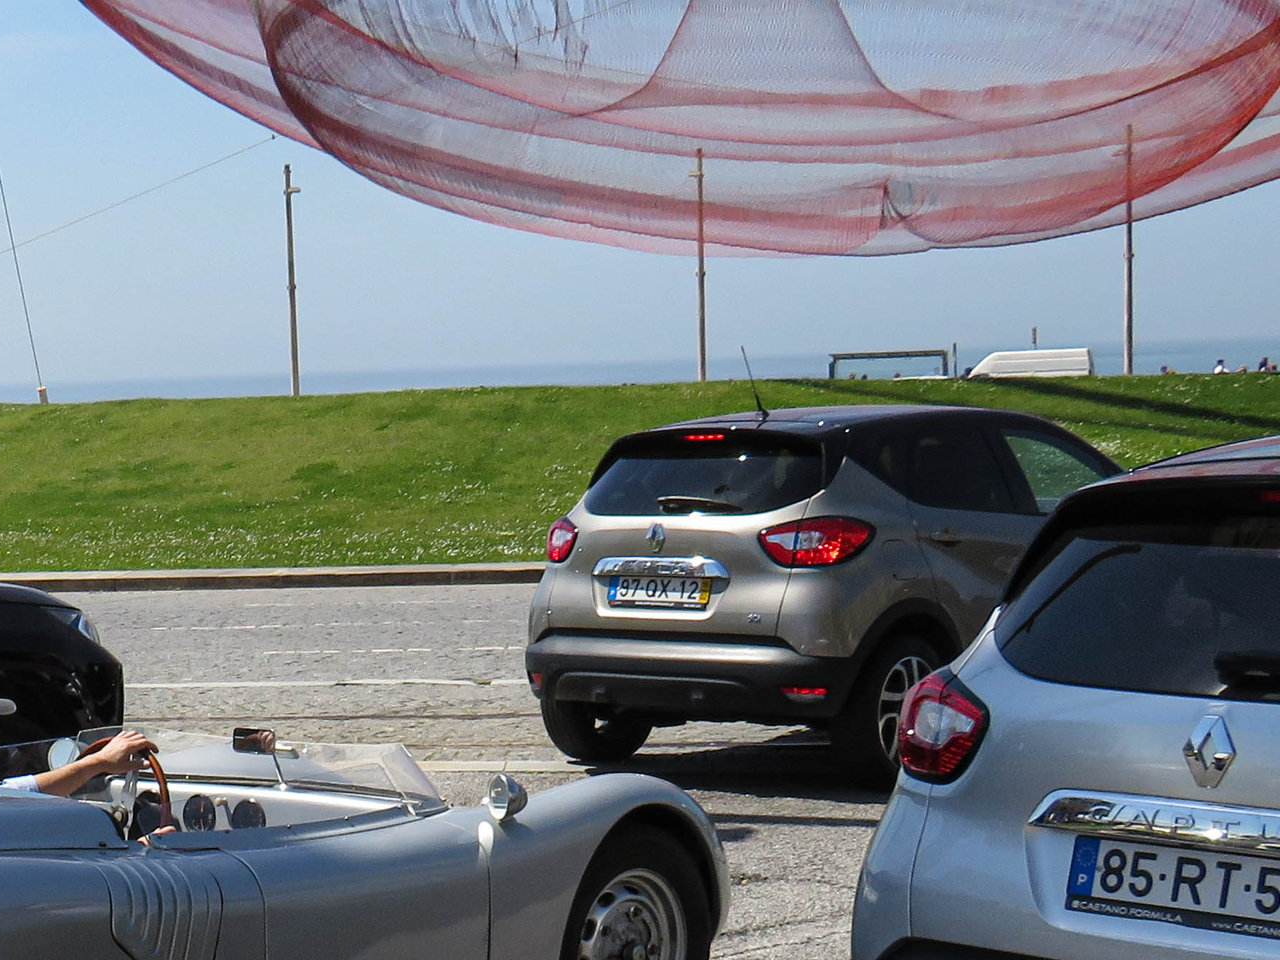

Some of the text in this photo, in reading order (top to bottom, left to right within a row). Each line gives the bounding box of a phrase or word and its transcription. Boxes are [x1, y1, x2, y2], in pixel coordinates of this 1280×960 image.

[1076, 873, 1088, 886] P
[1080, 901, 1182, 923] CAETANO FORMULA
